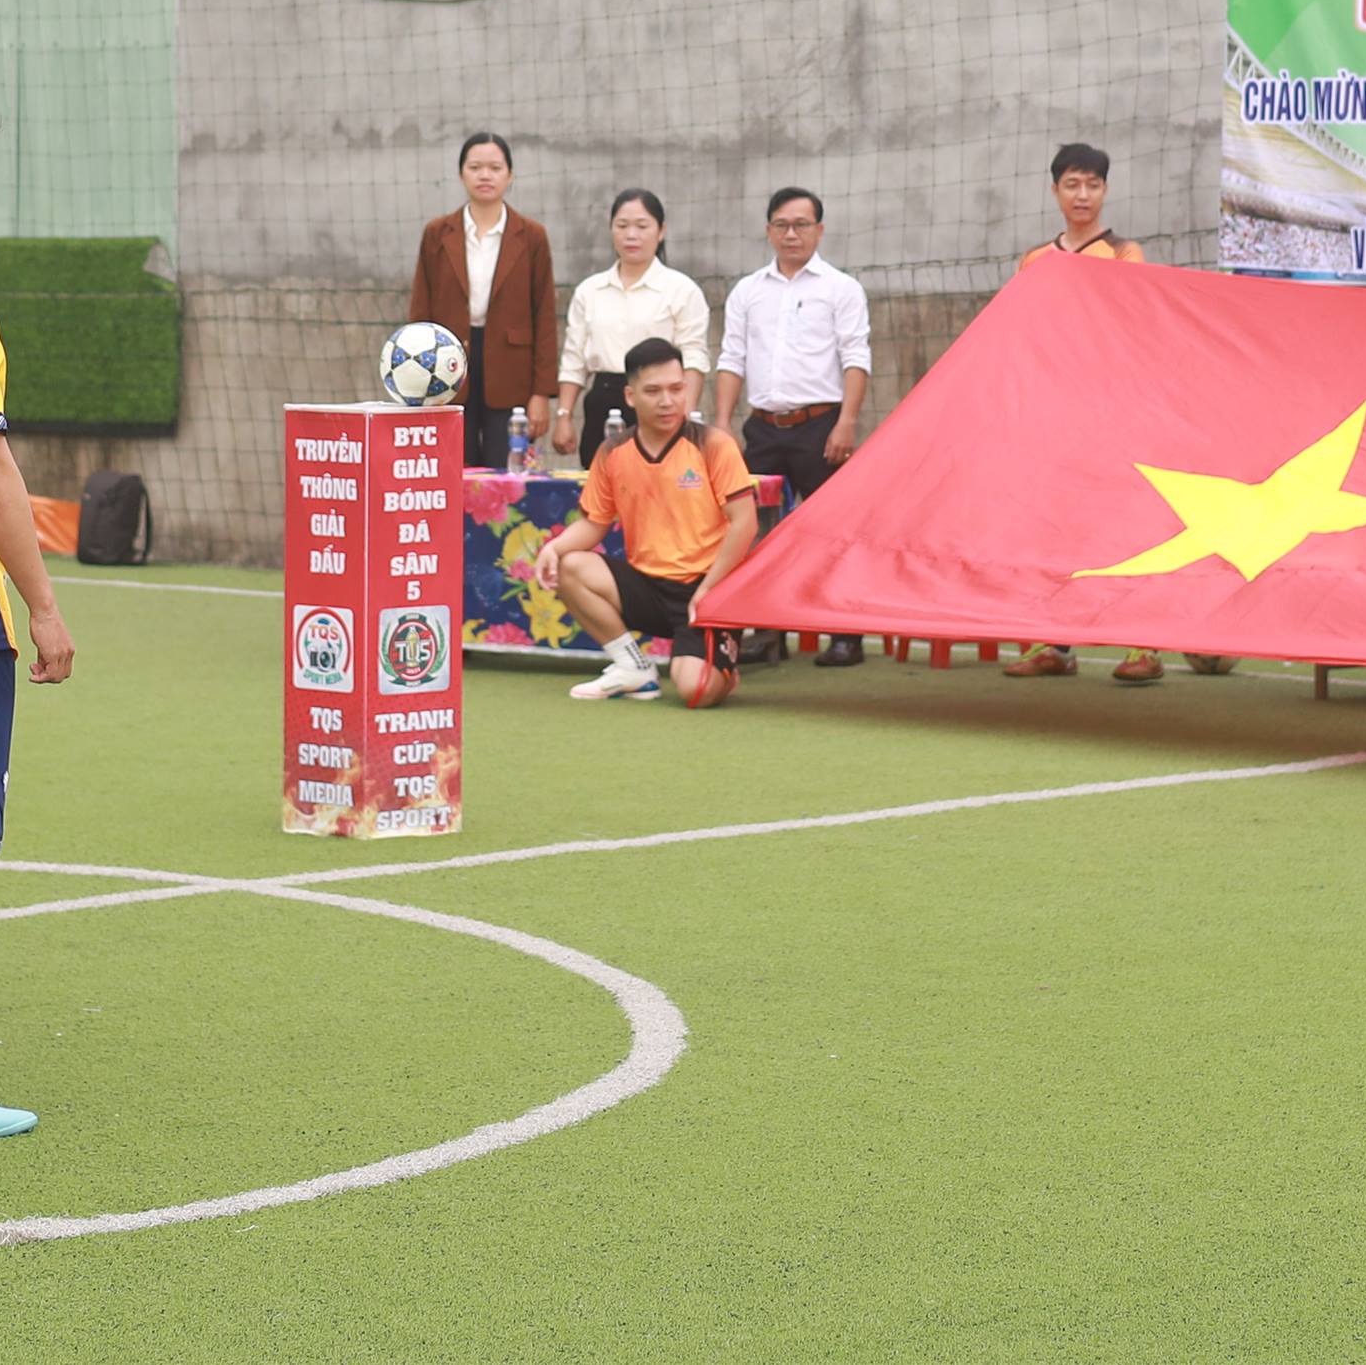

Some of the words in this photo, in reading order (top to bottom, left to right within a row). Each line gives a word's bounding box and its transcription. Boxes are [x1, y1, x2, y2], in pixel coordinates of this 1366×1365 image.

[1243, 71, 1308, 121] CHÀO
[394, 426, 438, 448] BTC
[299, 472, 358, 502] THÔNG
[383, 487, 448, 512] BÓNG
[398, 519, 431, 544] ĐÁ
[390, 551, 439, 577] SÂN
[406, 580, 421, 601] 5
[310, 707, 343, 734] TQS
[375, 709, 455, 734] TRANH
[298, 743, 353, 769] SPORT
[393, 740, 437, 766] CÚP
[298, 779, 354, 808] MEDIA
[394, 775, 437, 799] TQS
[377, 807, 452, 831] SPORT
